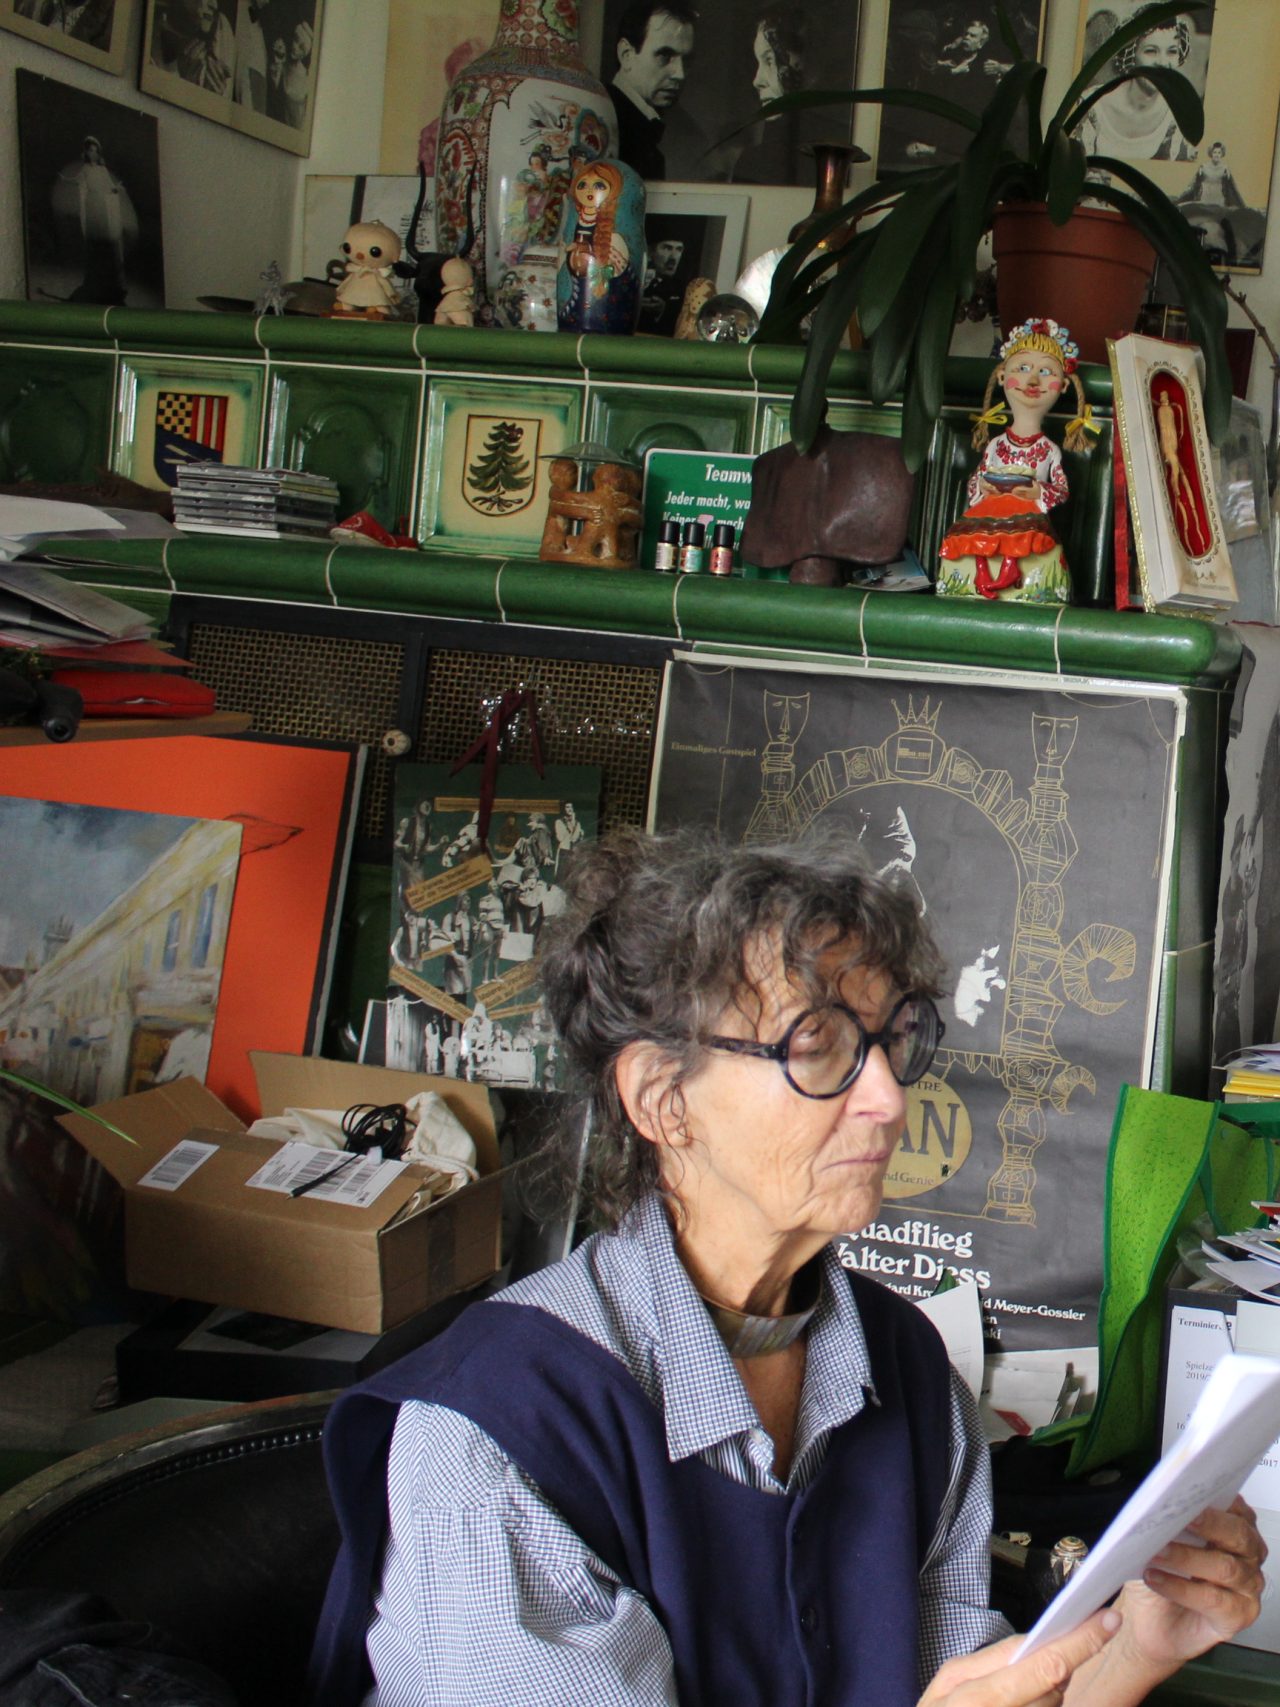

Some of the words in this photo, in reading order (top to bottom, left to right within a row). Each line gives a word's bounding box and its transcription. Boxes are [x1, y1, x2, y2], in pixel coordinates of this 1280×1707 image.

[664, 491, 695, 506] Jeder
[696, 493, 731, 510] macht,
[911, 1080, 942, 1093] TRE
[900, 1172, 934, 1186] Genie
[842, 1221, 973, 1258] uadflieg
[993, 1298, 1086, 1321] Meyer-Gossler
